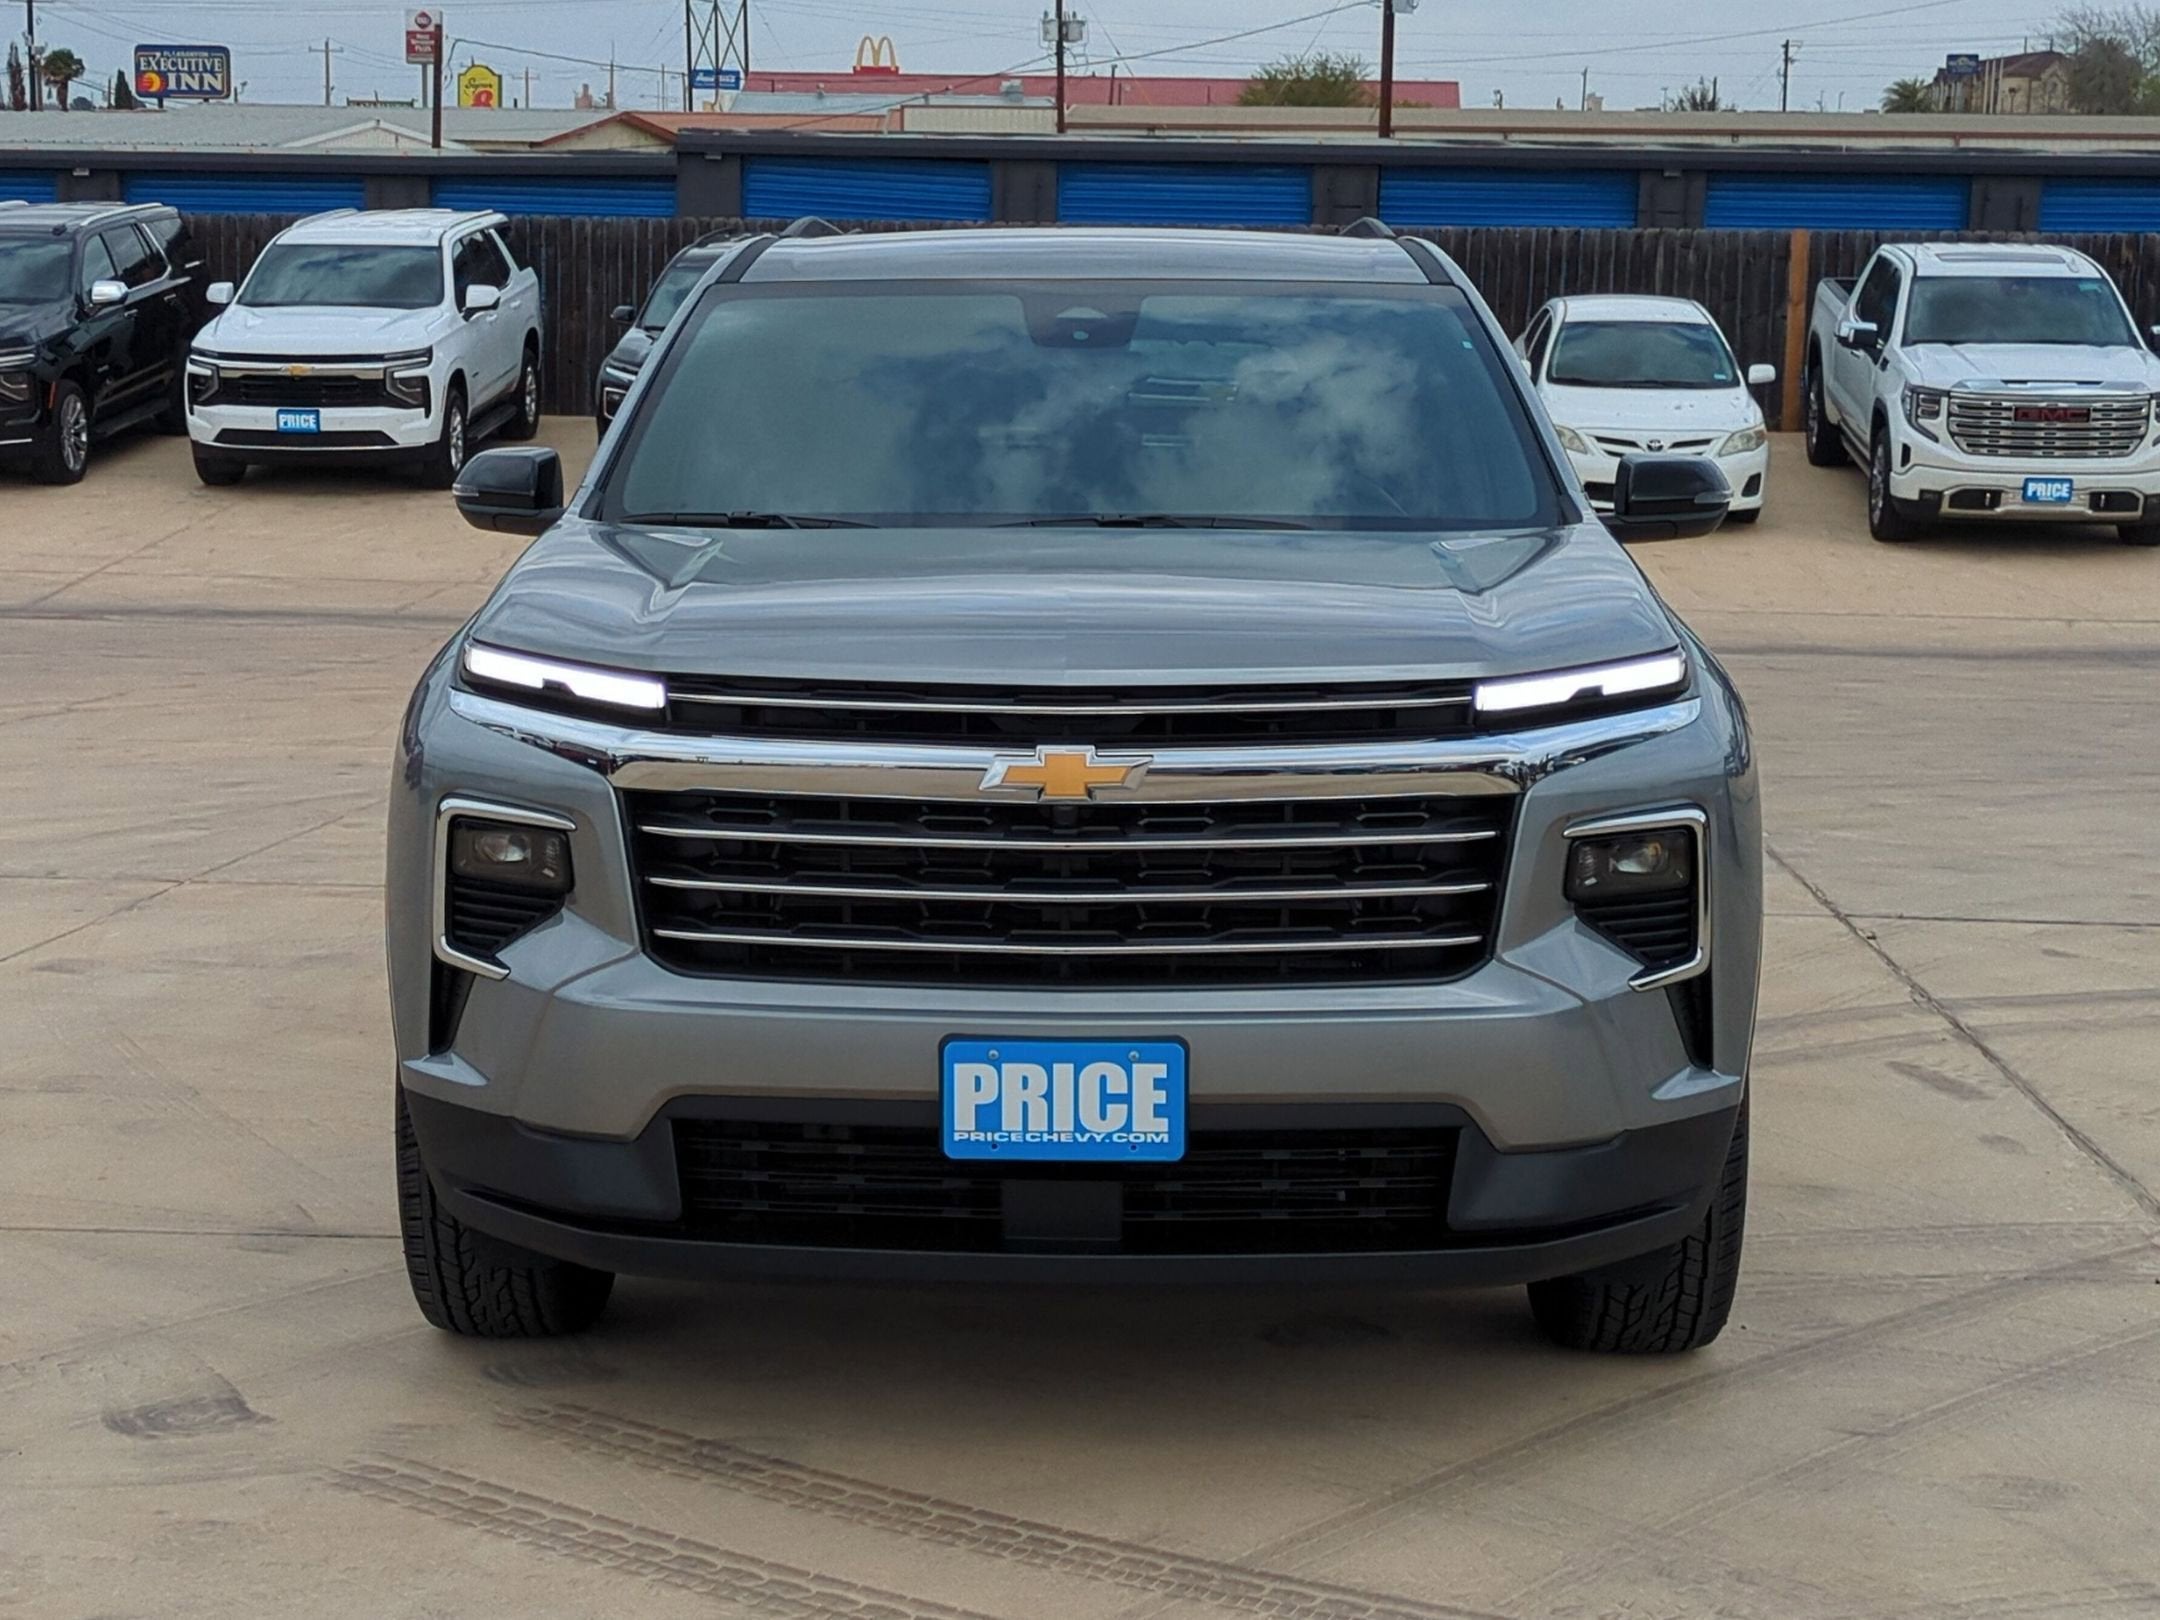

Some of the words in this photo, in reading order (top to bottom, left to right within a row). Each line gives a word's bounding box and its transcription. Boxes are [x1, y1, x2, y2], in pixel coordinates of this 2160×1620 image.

[140, 56, 222, 71] EXECUTIVE
[167, 73, 223, 91] INN
[279, 414, 317, 428] PRICE
[2016, 409, 2087, 421] GMC
[2027, 483, 2070, 497] PRICE
[953, 1062, 1169, 1132] PRICE
[953, 1132, 1169, 1143] PRICECHEVY.COM
